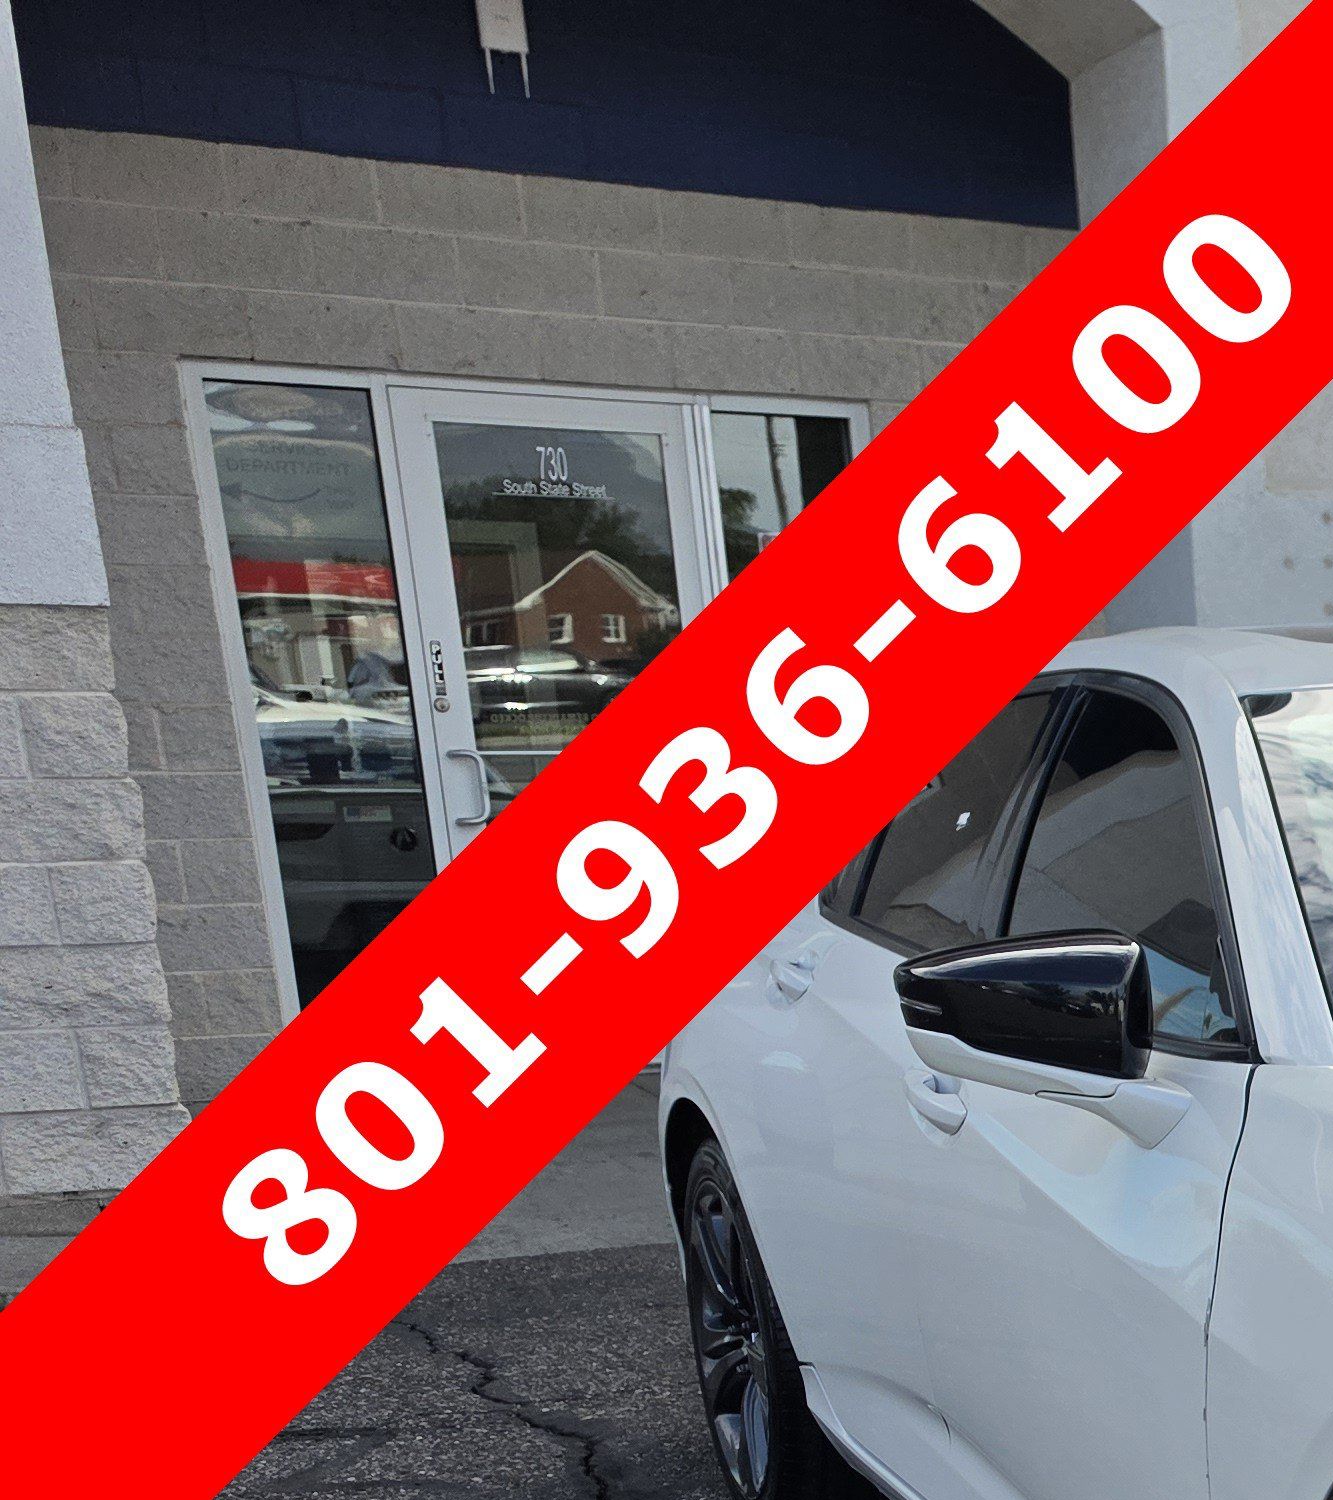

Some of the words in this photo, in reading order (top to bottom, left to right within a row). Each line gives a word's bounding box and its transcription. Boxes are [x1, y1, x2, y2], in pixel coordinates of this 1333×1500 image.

[535, 446, 568, 481] 730
[502, 479, 538, 494] South
[539, 480, 571, 496] State
[572, 482, 607, 498] Street
[431, 644, 444, 683] PULL
